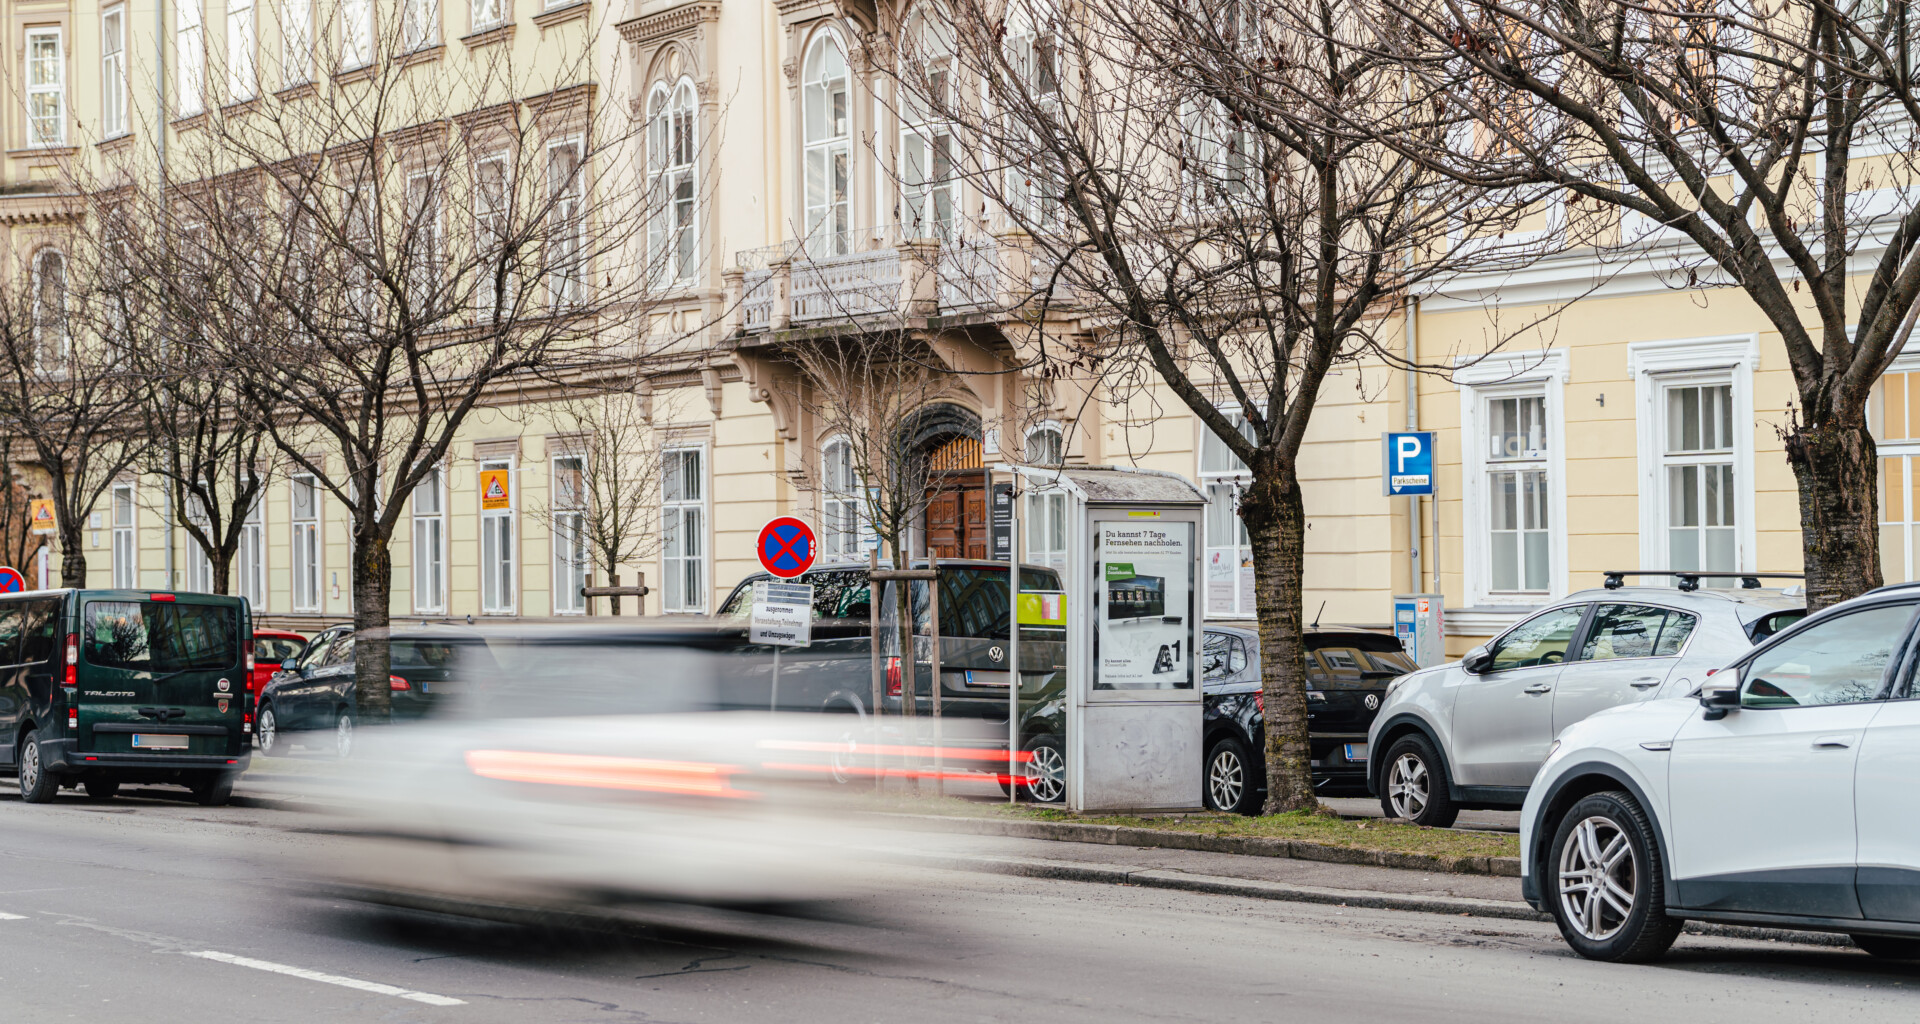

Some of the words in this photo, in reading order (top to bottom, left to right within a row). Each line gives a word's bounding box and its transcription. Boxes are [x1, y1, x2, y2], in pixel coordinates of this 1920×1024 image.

[1398, 436, 1421, 473] P
[1105, 530, 1115, 538] Du
[1117, 530, 1141, 538] kannst
[1143, 530, 1148, 538] 7
[1149, 531, 1166, 539] Tage
[1144, 539, 1183, 547] nachholen.
[766, 606, 794, 614] ausgenommen
[1152, 640, 1180, 674] A1
